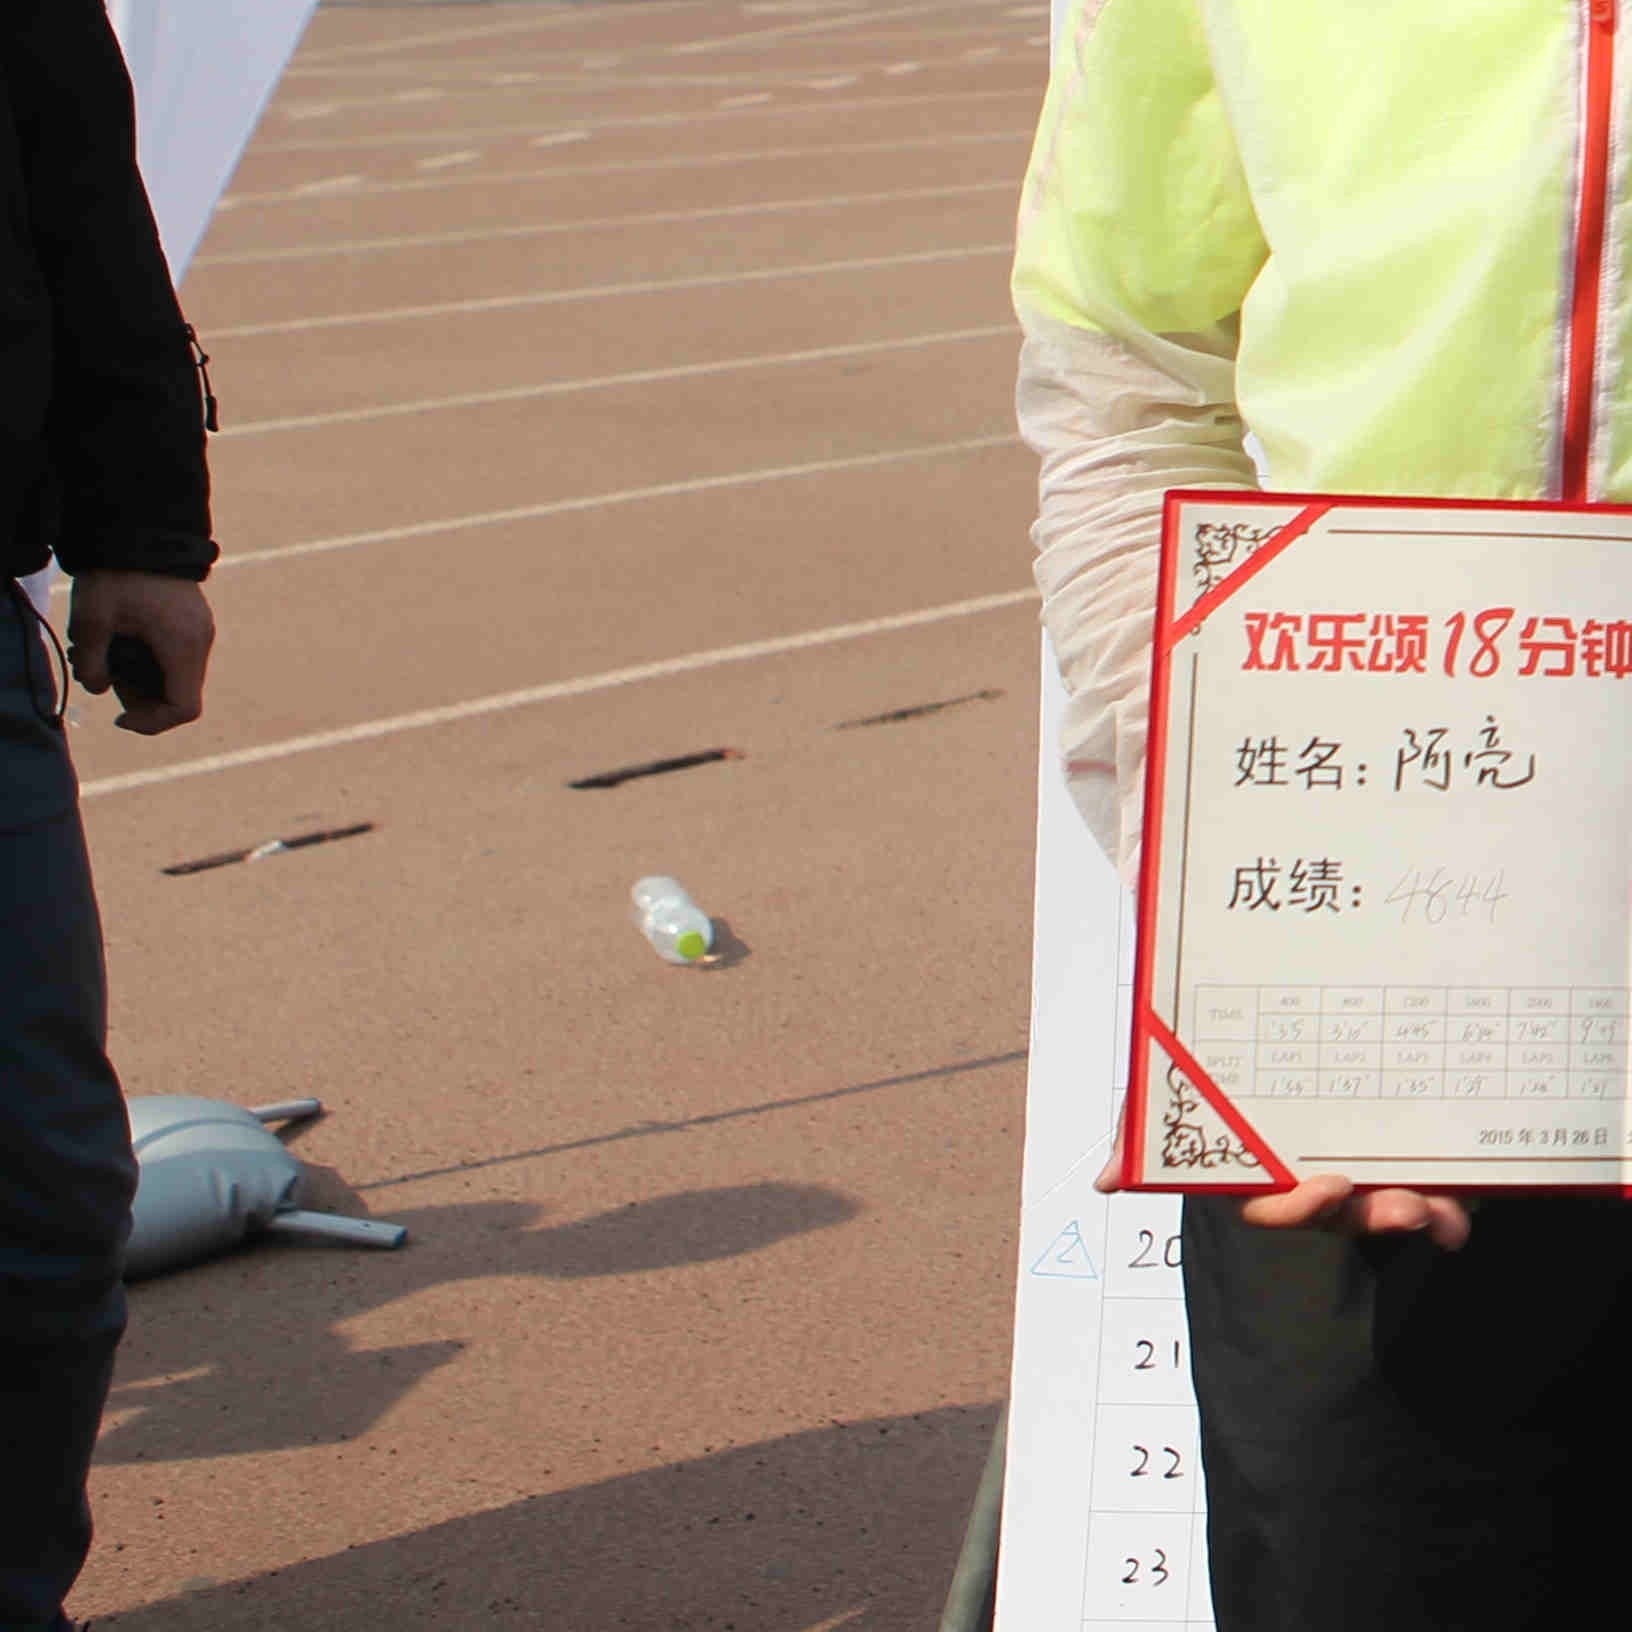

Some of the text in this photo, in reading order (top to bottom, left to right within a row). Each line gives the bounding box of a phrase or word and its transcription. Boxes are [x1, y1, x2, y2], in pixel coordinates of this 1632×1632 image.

[1135, 1339, 1180, 1370] 21
[1129, 1445, 1184, 1479] 22
[1121, 1548, 1169, 1587] 23
